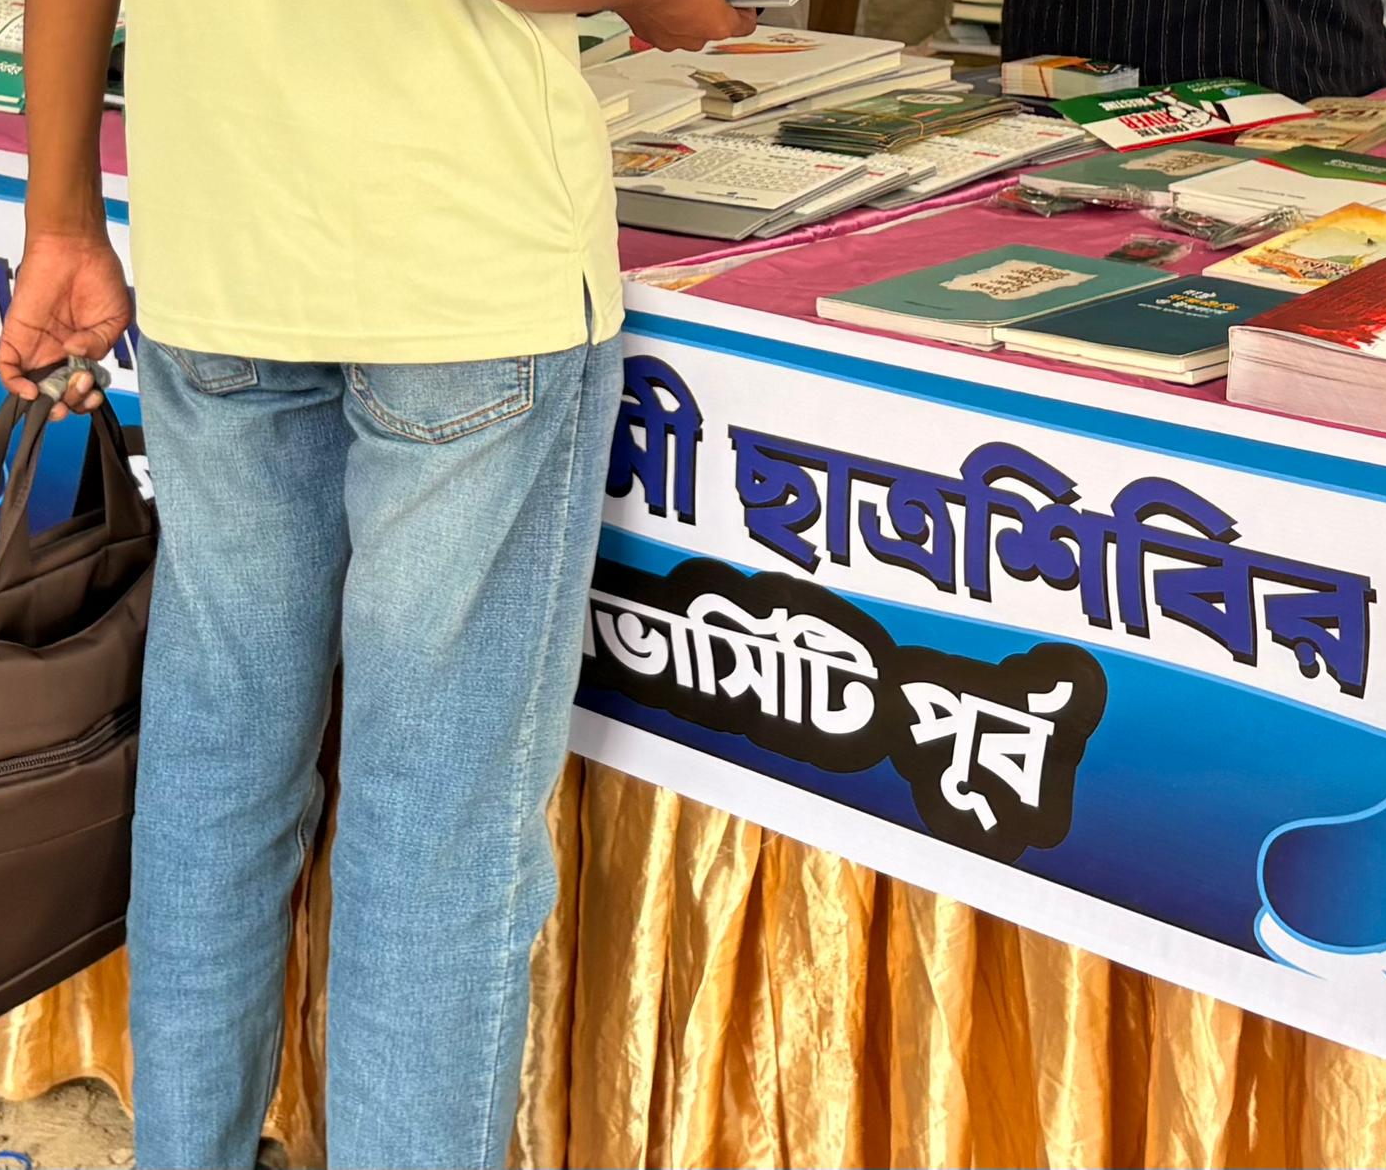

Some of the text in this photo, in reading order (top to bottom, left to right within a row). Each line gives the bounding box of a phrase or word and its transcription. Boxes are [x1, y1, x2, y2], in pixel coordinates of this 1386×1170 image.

[729, 426, 1377, 699] ছাত্রশিবির
[585, 590, 1074, 831] ভার্সিটি পূর্ব
